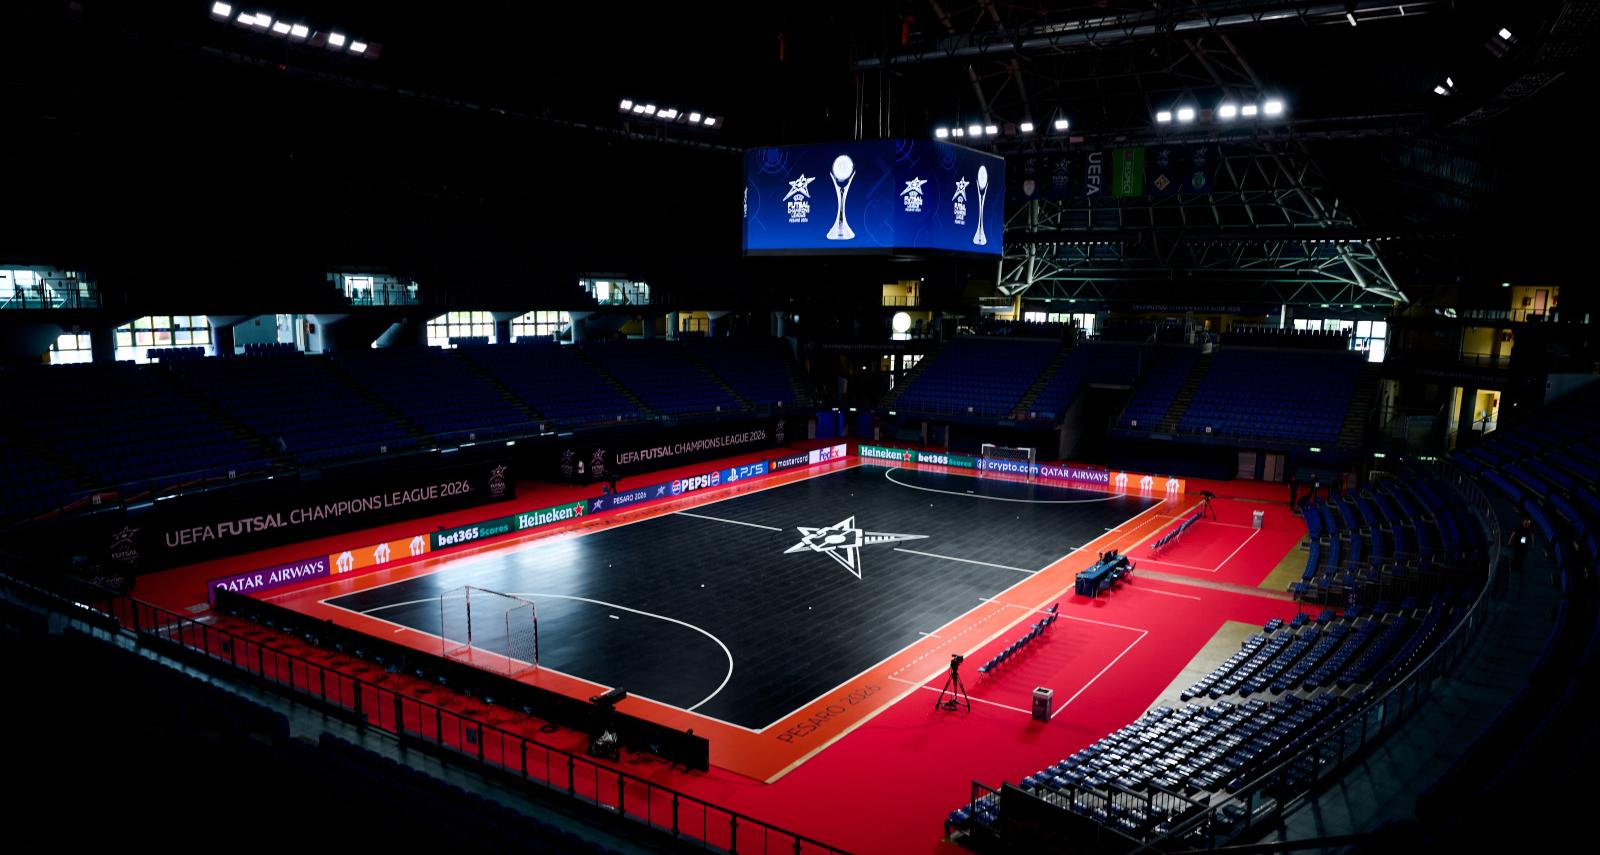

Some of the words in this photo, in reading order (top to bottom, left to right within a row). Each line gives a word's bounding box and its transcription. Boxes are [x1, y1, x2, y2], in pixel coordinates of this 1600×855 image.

[1087, 151, 1103, 195] UEFA
[616, 447, 641, 466] UEFA
[640, 441, 674, 461] FUTSAL
[674, 435, 721, 455] CHAMPIONS
[721, 432, 750, 447] LEAGUE
[750, 429, 767, 443] 2026
[861, 446, 903, 460] Heineken
[777, 452, 809, 468] mastercard
[918, 452, 949, 465] bet365
[949, 457, 972, 468] Scores
[988, 461, 1039, 475] crypto.com
[739, 464, 764, 478] PS5
[1040, 466, 1069, 479] QATAR
[1071, 470, 1109, 482] AIRWAYS
[681, 473, 711, 492] PEPSI
[613, 493, 635, 505] PESARO
[635, 490, 649, 501] 2026
[165, 524, 216, 549] UEFA
[217, 511, 289, 538] FUTSAL
[289, 494, 383, 526] CHAMPIONS
[384, 484, 439, 509] LEAGUE
[440, 479, 471, 498] 2026
[518, 508, 574, 530] Heineken
[438, 527, 479, 547] bet365
[479, 524, 509, 537] Scores
[269, 560, 325, 585] AIRWAYS
[776, 704, 846, 744] PESARO
